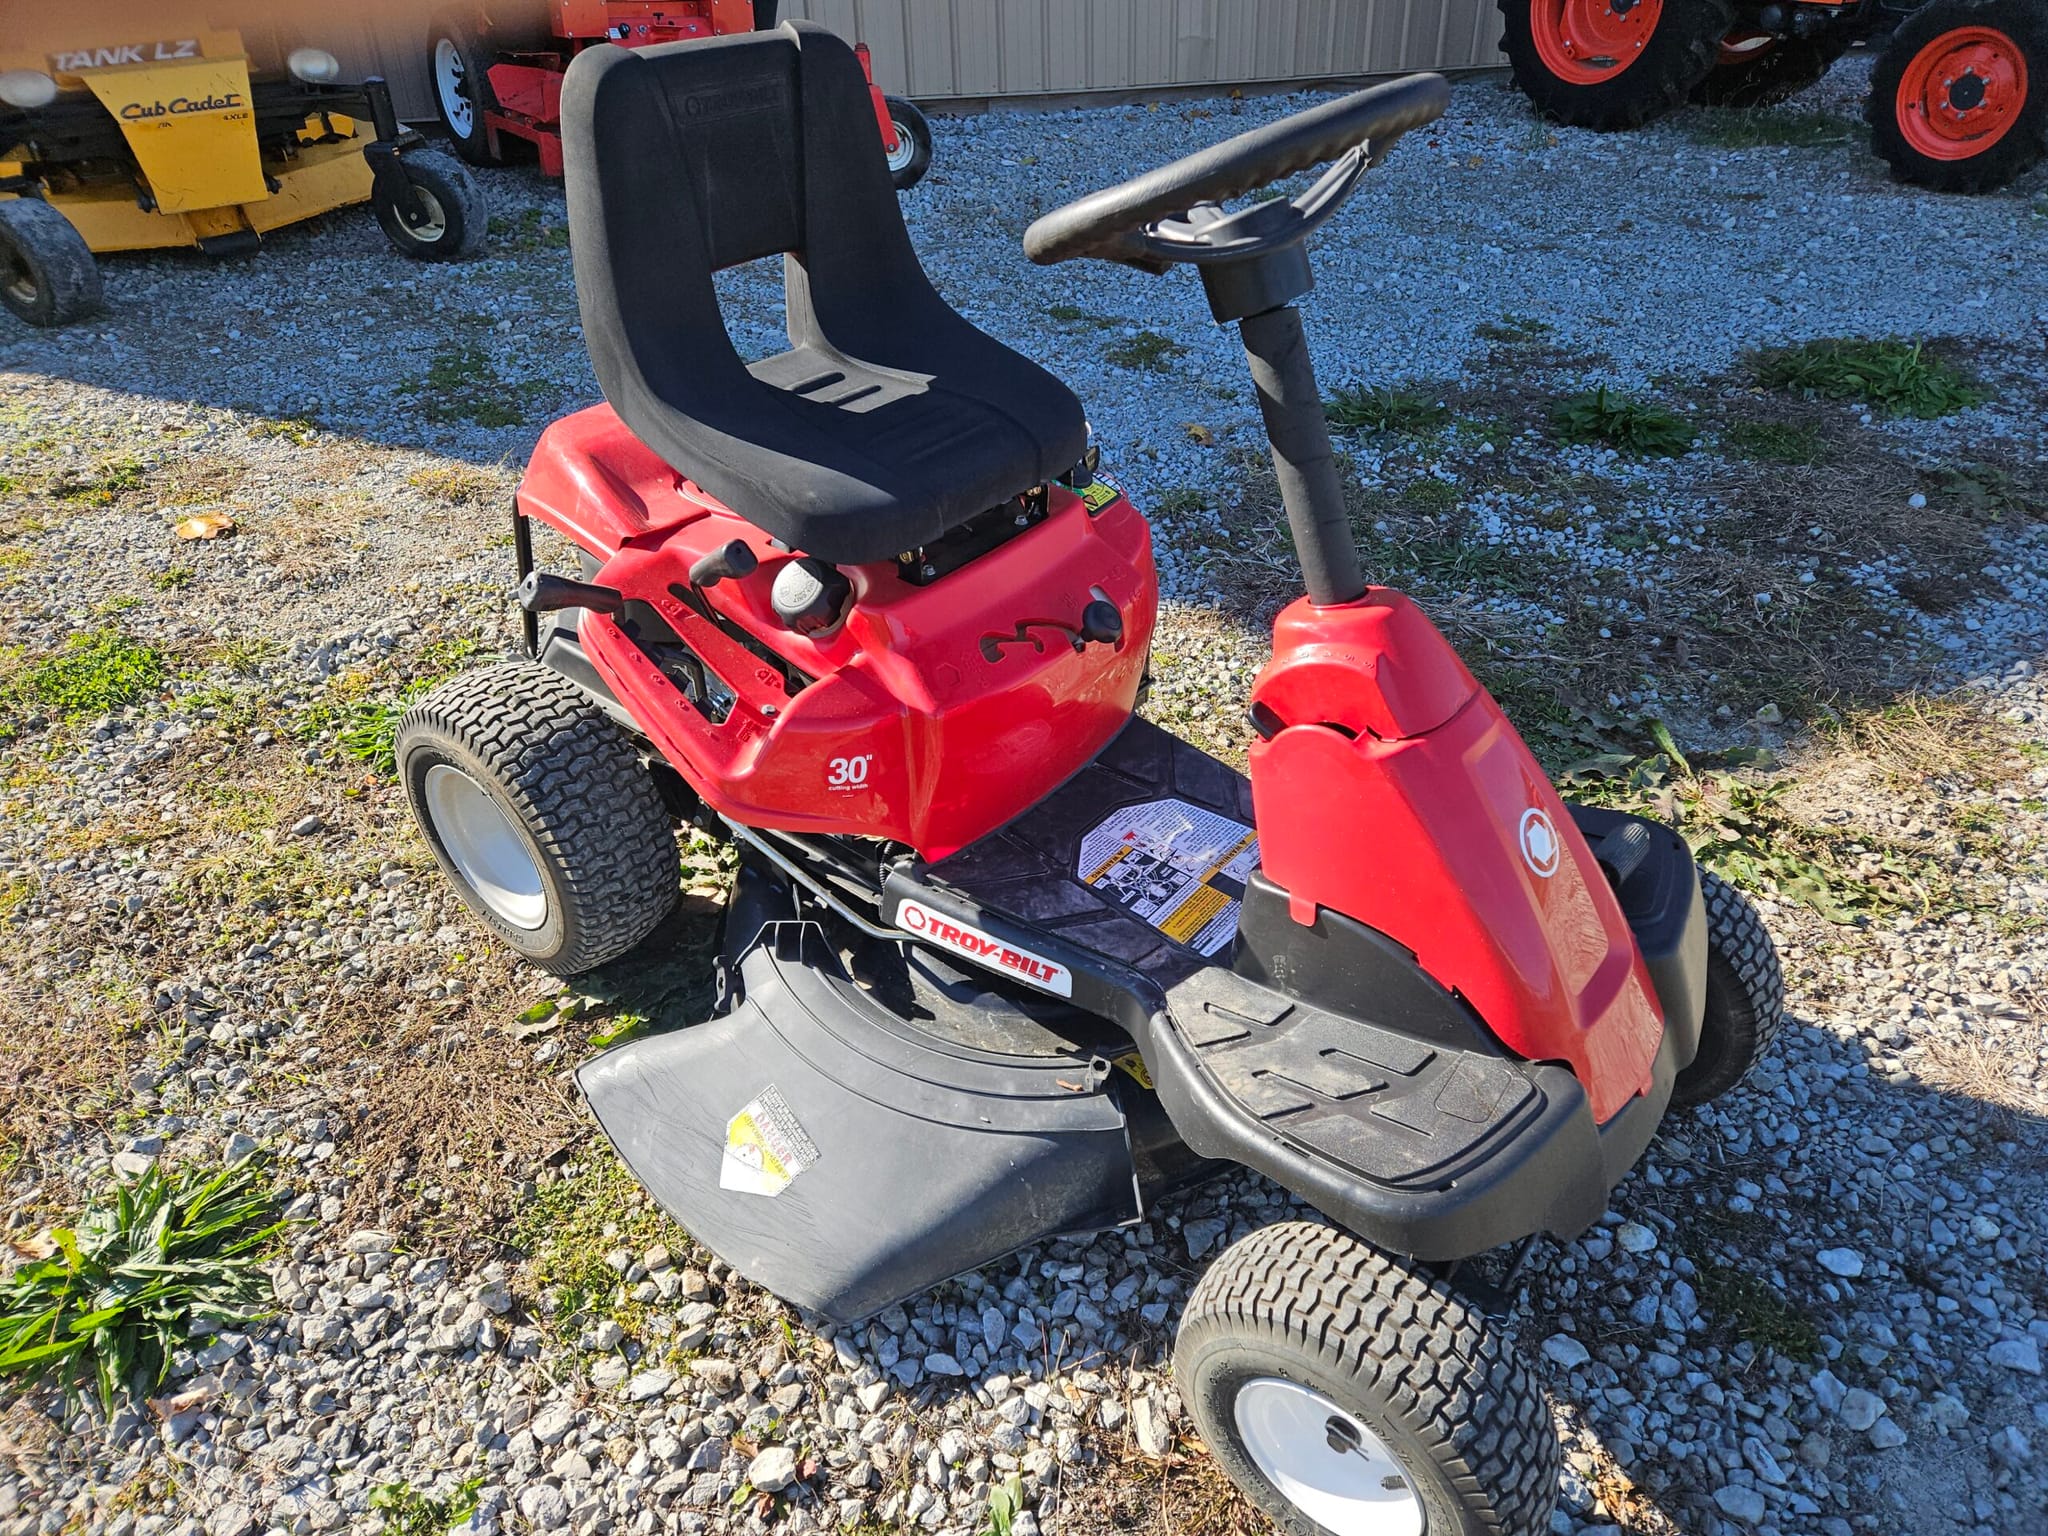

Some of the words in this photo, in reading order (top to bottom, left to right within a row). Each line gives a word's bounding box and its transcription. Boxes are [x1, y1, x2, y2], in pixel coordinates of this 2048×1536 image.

[54, 44, 144, 72] TANK
[154, 38, 197, 60] LZ
[120, 100, 167, 119] Cub
[168, 93, 241, 114] Cadet
[828, 754, 873, 785] 30"
[1090, 855, 1121, 879] WARNING
[1213, 845, 1243, 869] WARNING
[928, 916, 1060, 984] TROY-BILT
